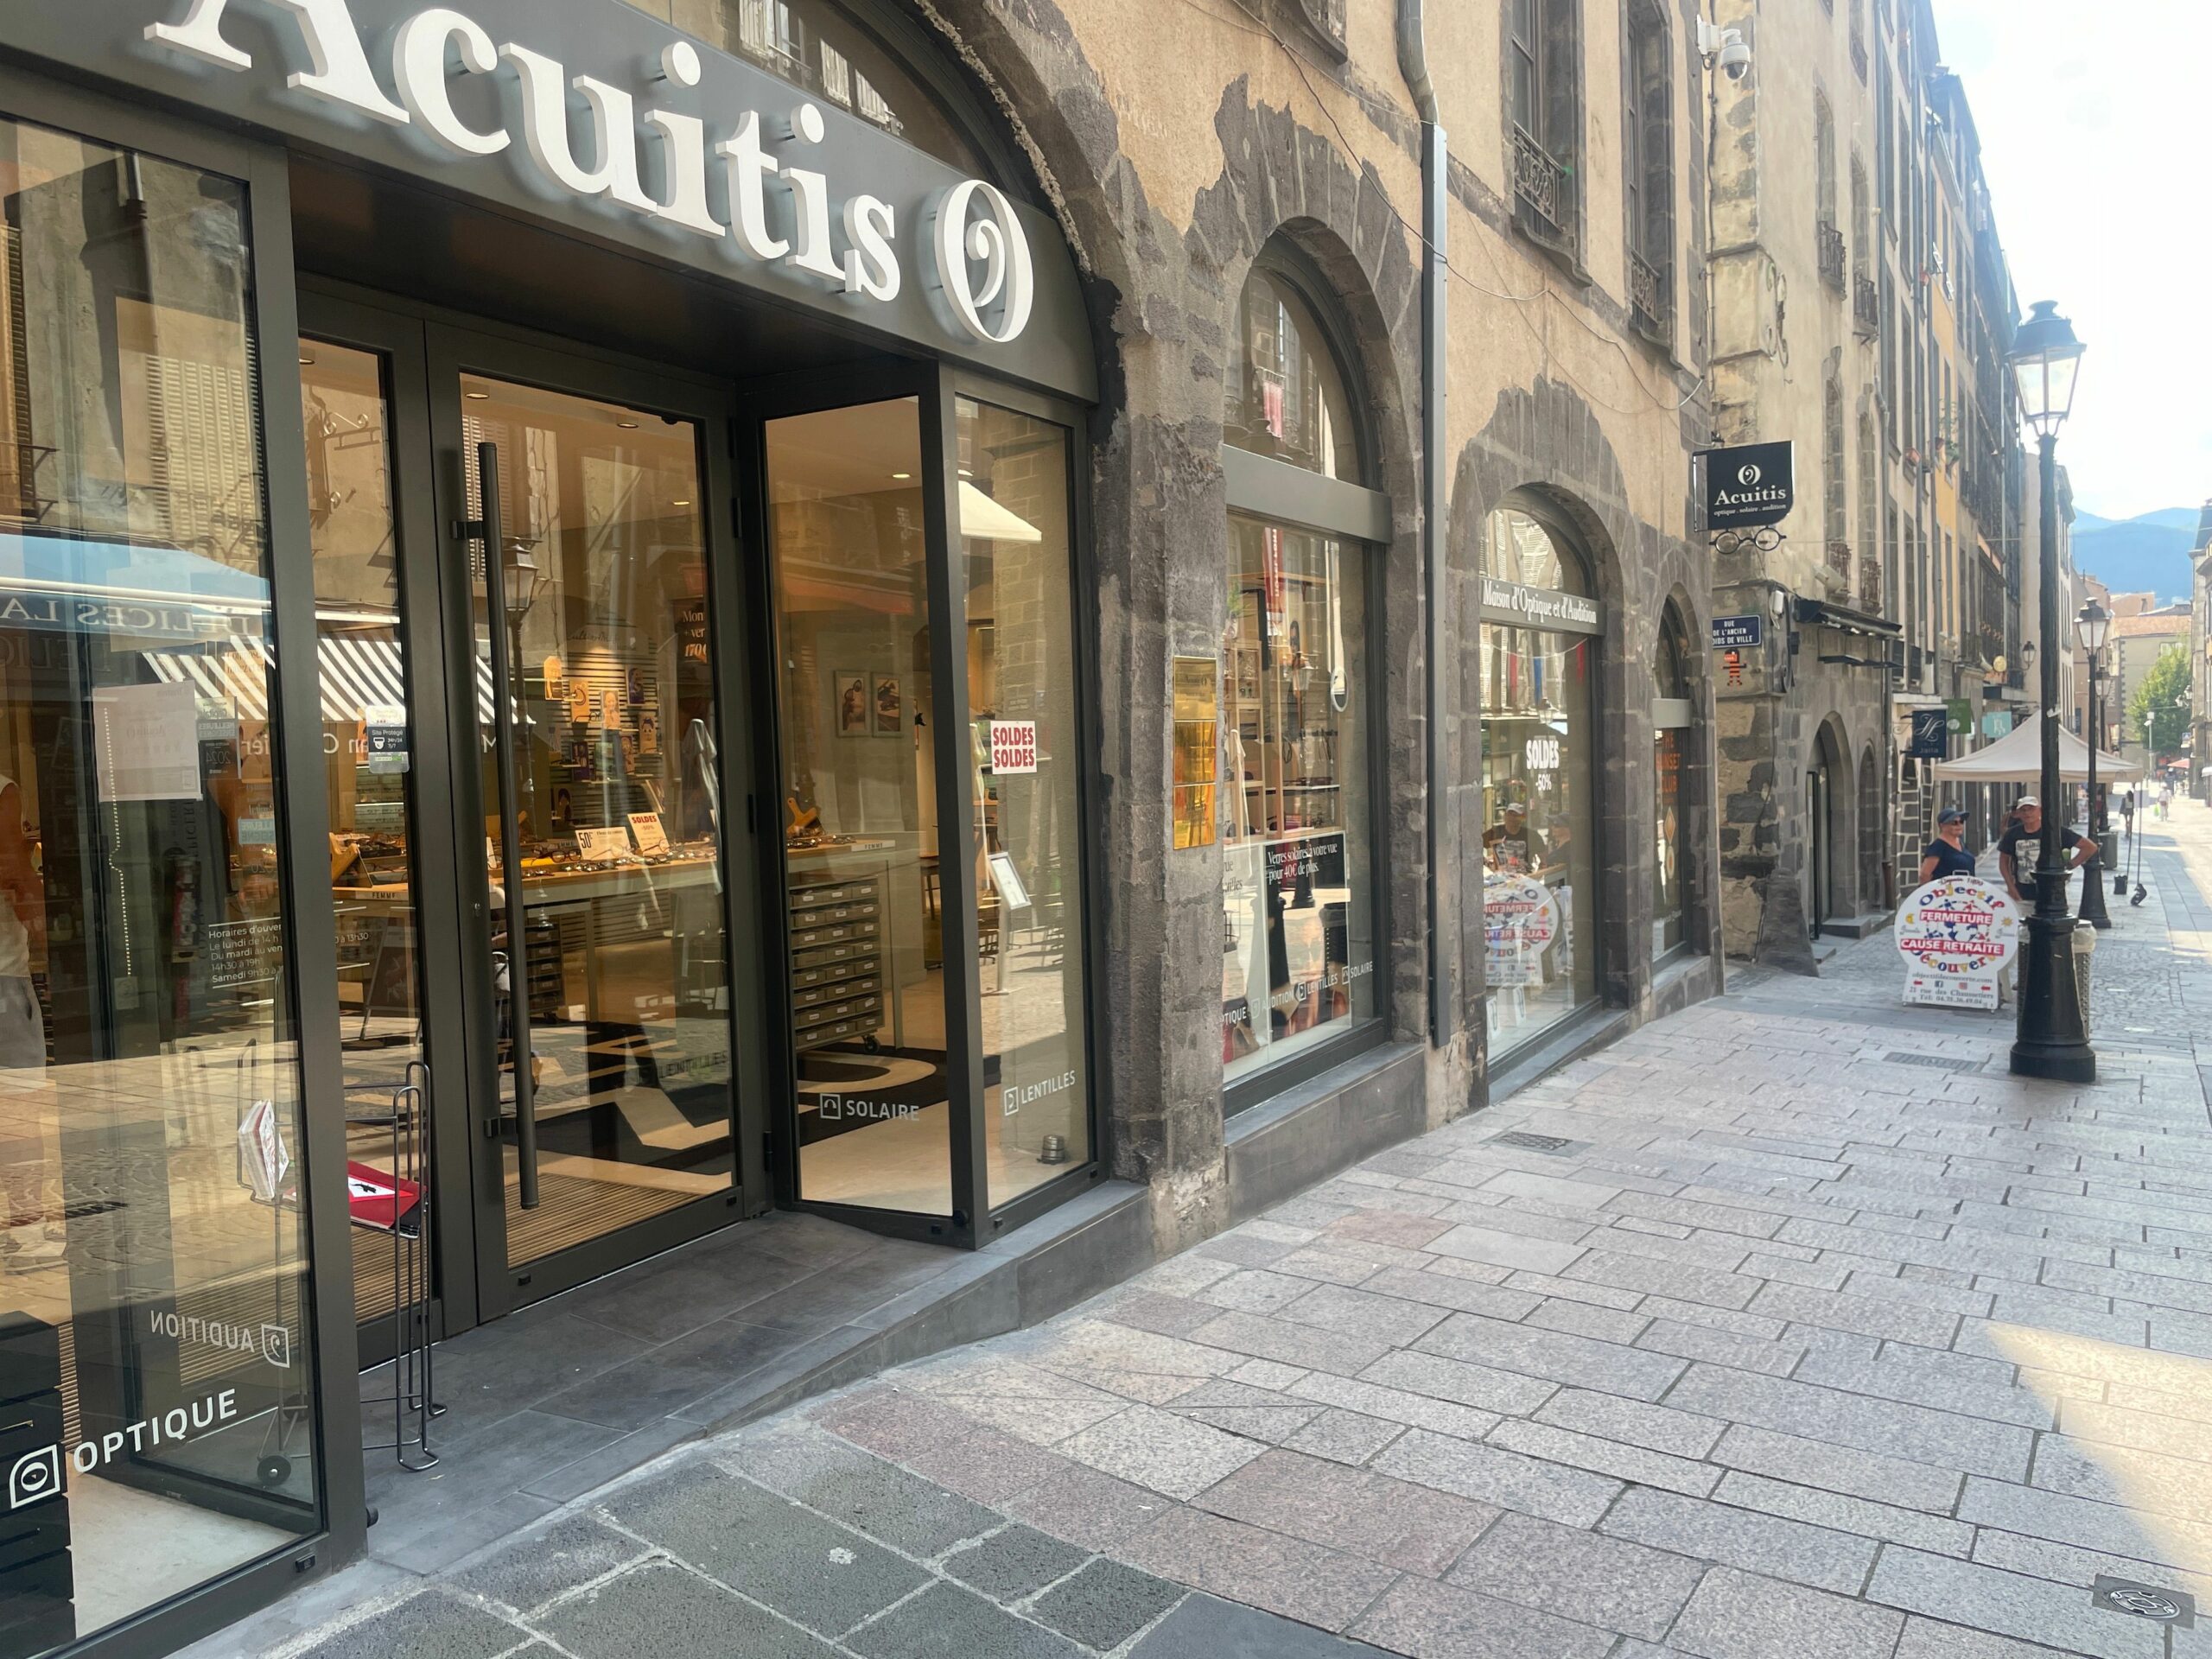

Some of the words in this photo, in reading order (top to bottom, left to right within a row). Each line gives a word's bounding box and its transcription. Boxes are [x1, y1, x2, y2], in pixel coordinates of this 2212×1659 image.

[143, 0, 901, 302] Acuitis
[1714, 485, 1786, 505] Acuitis
[1713, 508, 1736, 517] optique
[1483, 580, 1510, 610] Maison
[1511, 586, 1552, 623] d'Optique
[1553, 601, 1560, 617] et
[1560, 596, 1597, 624] d'Audition
[1713, 637, 1726, 645] OIDS
[1736, 635, 1753, 644] VILLE
[1721, 627, 1747, 636] L'ANCIEN
[993, 727, 1034, 747] SOLDES
[995, 748, 1035, 768] SOLDES
[1526, 739, 1560, 770] SOLDES
[1535, 773, 1552, 791] -50%
[632, 815, 658, 824] SOLDES
[1268, 850, 1287, 865] Verres
[1287, 845, 1308, 861] solaires
[1313, 845, 1328, 857] votre
[1327, 842, 1338, 854] vue
[1268, 868, 1284, 885] pour
[1284, 862, 1298, 878] 40€
[1298, 861, 1306, 875] de
[1919, 881, 2005, 910] Objectif
[1920, 911, 1993, 925] FERMETURE
[208, 927, 247, 939] Horaires
[210, 942, 220, 951] Le
[222, 938, 246, 950] lundi
[248, 936, 259, 946] de
[1901, 938, 1941, 950] CAUSE
[1942, 940, 2003, 955] RETRAITE
[211, 951, 224, 961] Du
[226, 949, 252, 959] mardi
[255, 947, 265, 956] au
[212, 961, 236, 971] 14h30
[213, 970, 247, 983] Samedi
[247, 968, 269, 978] 9h30
[1350, 960, 1374, 979] SOLAIRE
[1306, 972, 1338, 995] LENTILLES
[1262, 990, 1295, 1011] AUDITION
[1222, 1006, 1248, 1026] TIQUE
[1021, 1069, 1076, 1106] LENTILLES
[846, 1099, 920, 1122] SOLAIRE
[73, 1388, 238, 1474] OPTIQUE
